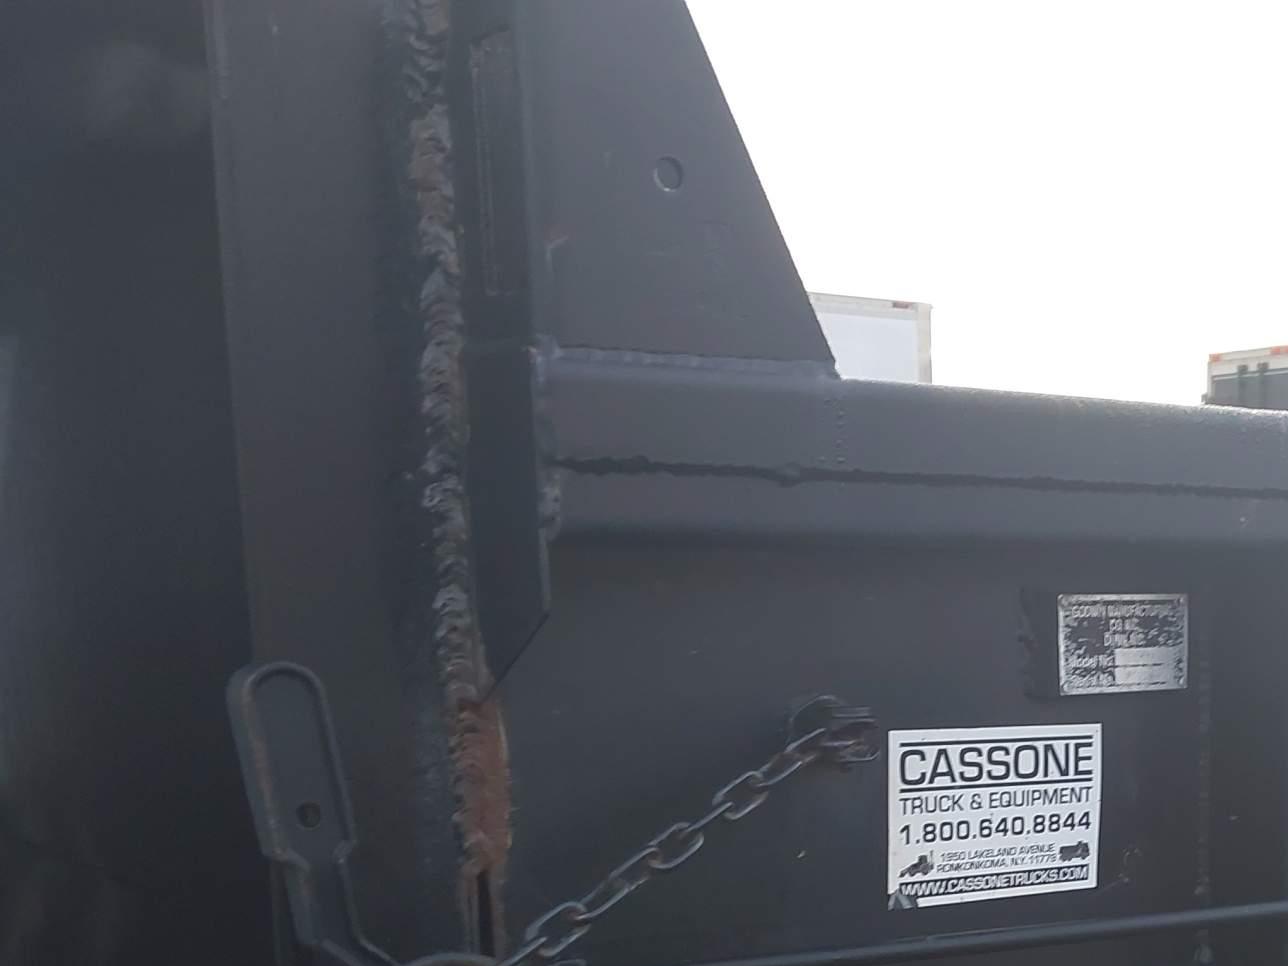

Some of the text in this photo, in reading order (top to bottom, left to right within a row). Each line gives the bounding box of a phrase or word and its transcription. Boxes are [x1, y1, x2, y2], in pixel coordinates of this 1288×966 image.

[899, 742, 1093, 786] CASSONE
[899, 786, 1092, 815] TRUCK & EQUIPMENT
[900, 811, 1091, 845] 1.800.640.8844
[968, 847, 1017, 860] LAKELAND
[1019, 843, 1056, 855] AVENUE
[901, 866, 1088, 896] WWW.CASSONETRUCKS.COM
